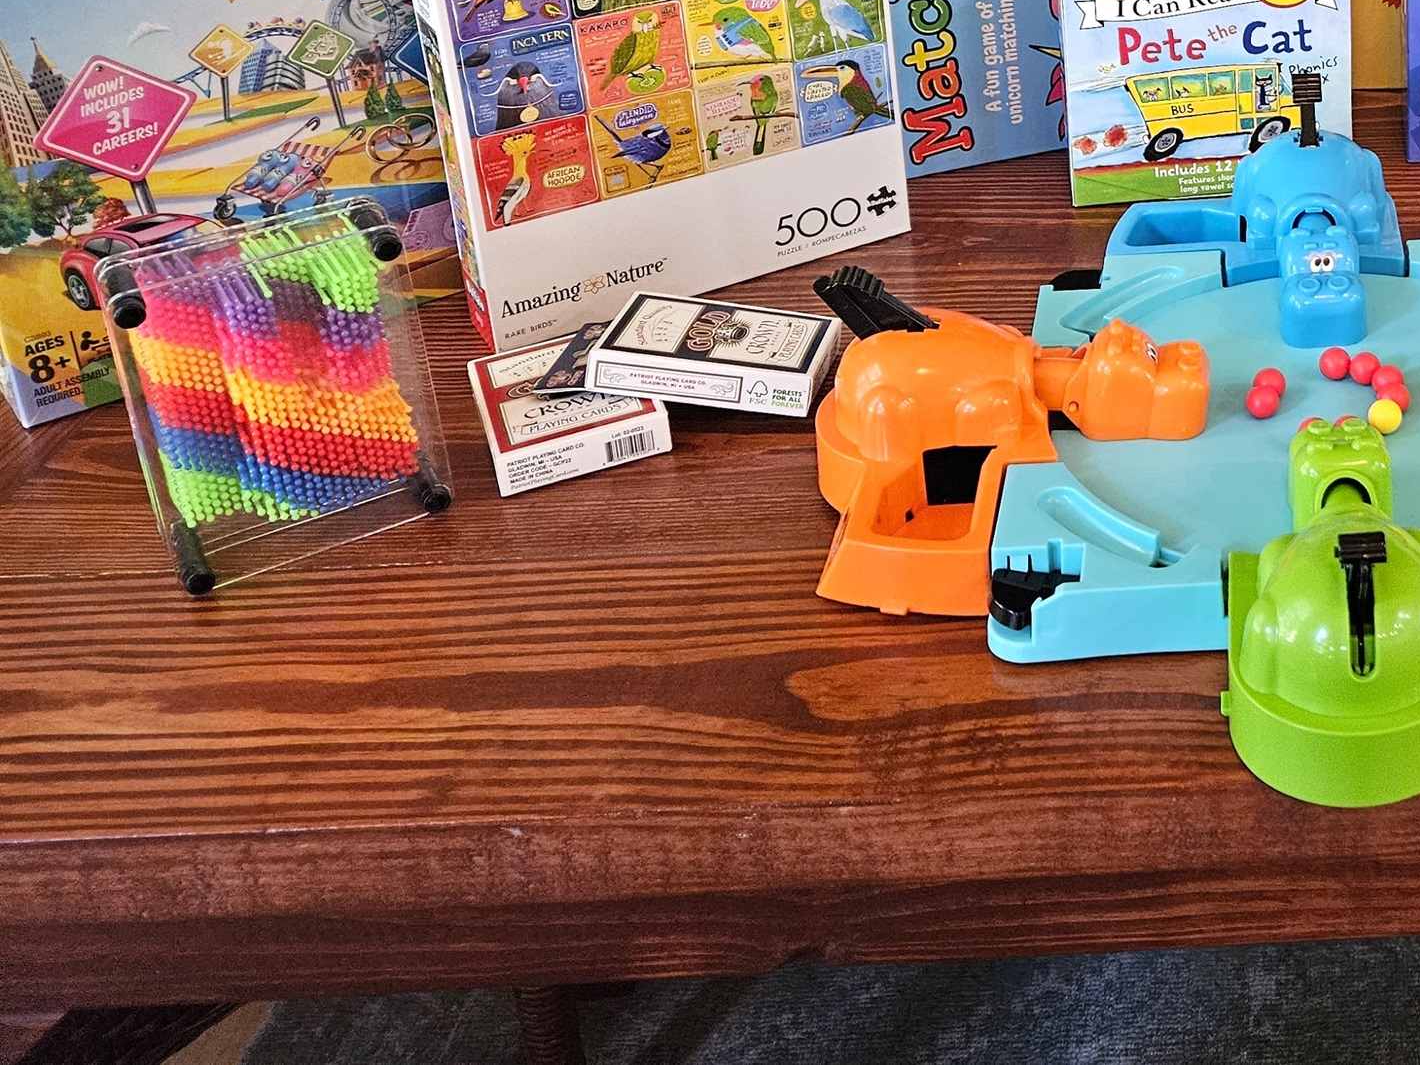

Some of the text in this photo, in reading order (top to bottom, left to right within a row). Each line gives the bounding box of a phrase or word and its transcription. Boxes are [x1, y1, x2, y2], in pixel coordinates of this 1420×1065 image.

[1116, 0, 1125, 18] I
[512, 37, 538, 49] INCA
[540, 28, 569, 44] TERN
[579, 18, 628, 34] KAKAPO
[1117, 19, 1312, 65] Pete the Cat
[975, 1, 1002, 112] A fun game of
[84, 76, 124, 100] WOW!
[1005, 66, 1023, 125] unicorn
[81, 87, 145, 117] INCLUDES
[1171, 104, 1194, 116] BUS
[106, 107, 130, 133] 31
[92, 122, 158, 155] CAREERS!
[1155, 160, 1232, 177] Includes 12
[1179, 176, 1215, 185] Features
[1180, 182, 1224, 193] long vowel
[775, 197, 861, 247] 500
[777, 225, 867, 257] PUZZLE ROMPECABEZAS
[500, 282, 581, 318] Amazing
[605, 258, 664, 288] Nature
[505, 320, 553, 339] RARE BIRDS
[687, 311, 731, 352] GOLD
[25, 335, 65, 356] AGES
[28, 355, 70, 383] 8+
[34, 367, 109, 397] ADULT ASSEMBLY
[772, 389, 802, 397] FORESTS
[36, 387, 84, 407] REQUIRED.
[771, 401, 804, 410] FOREVER
[530, 404, 621, 433] PLAYING CARDS
